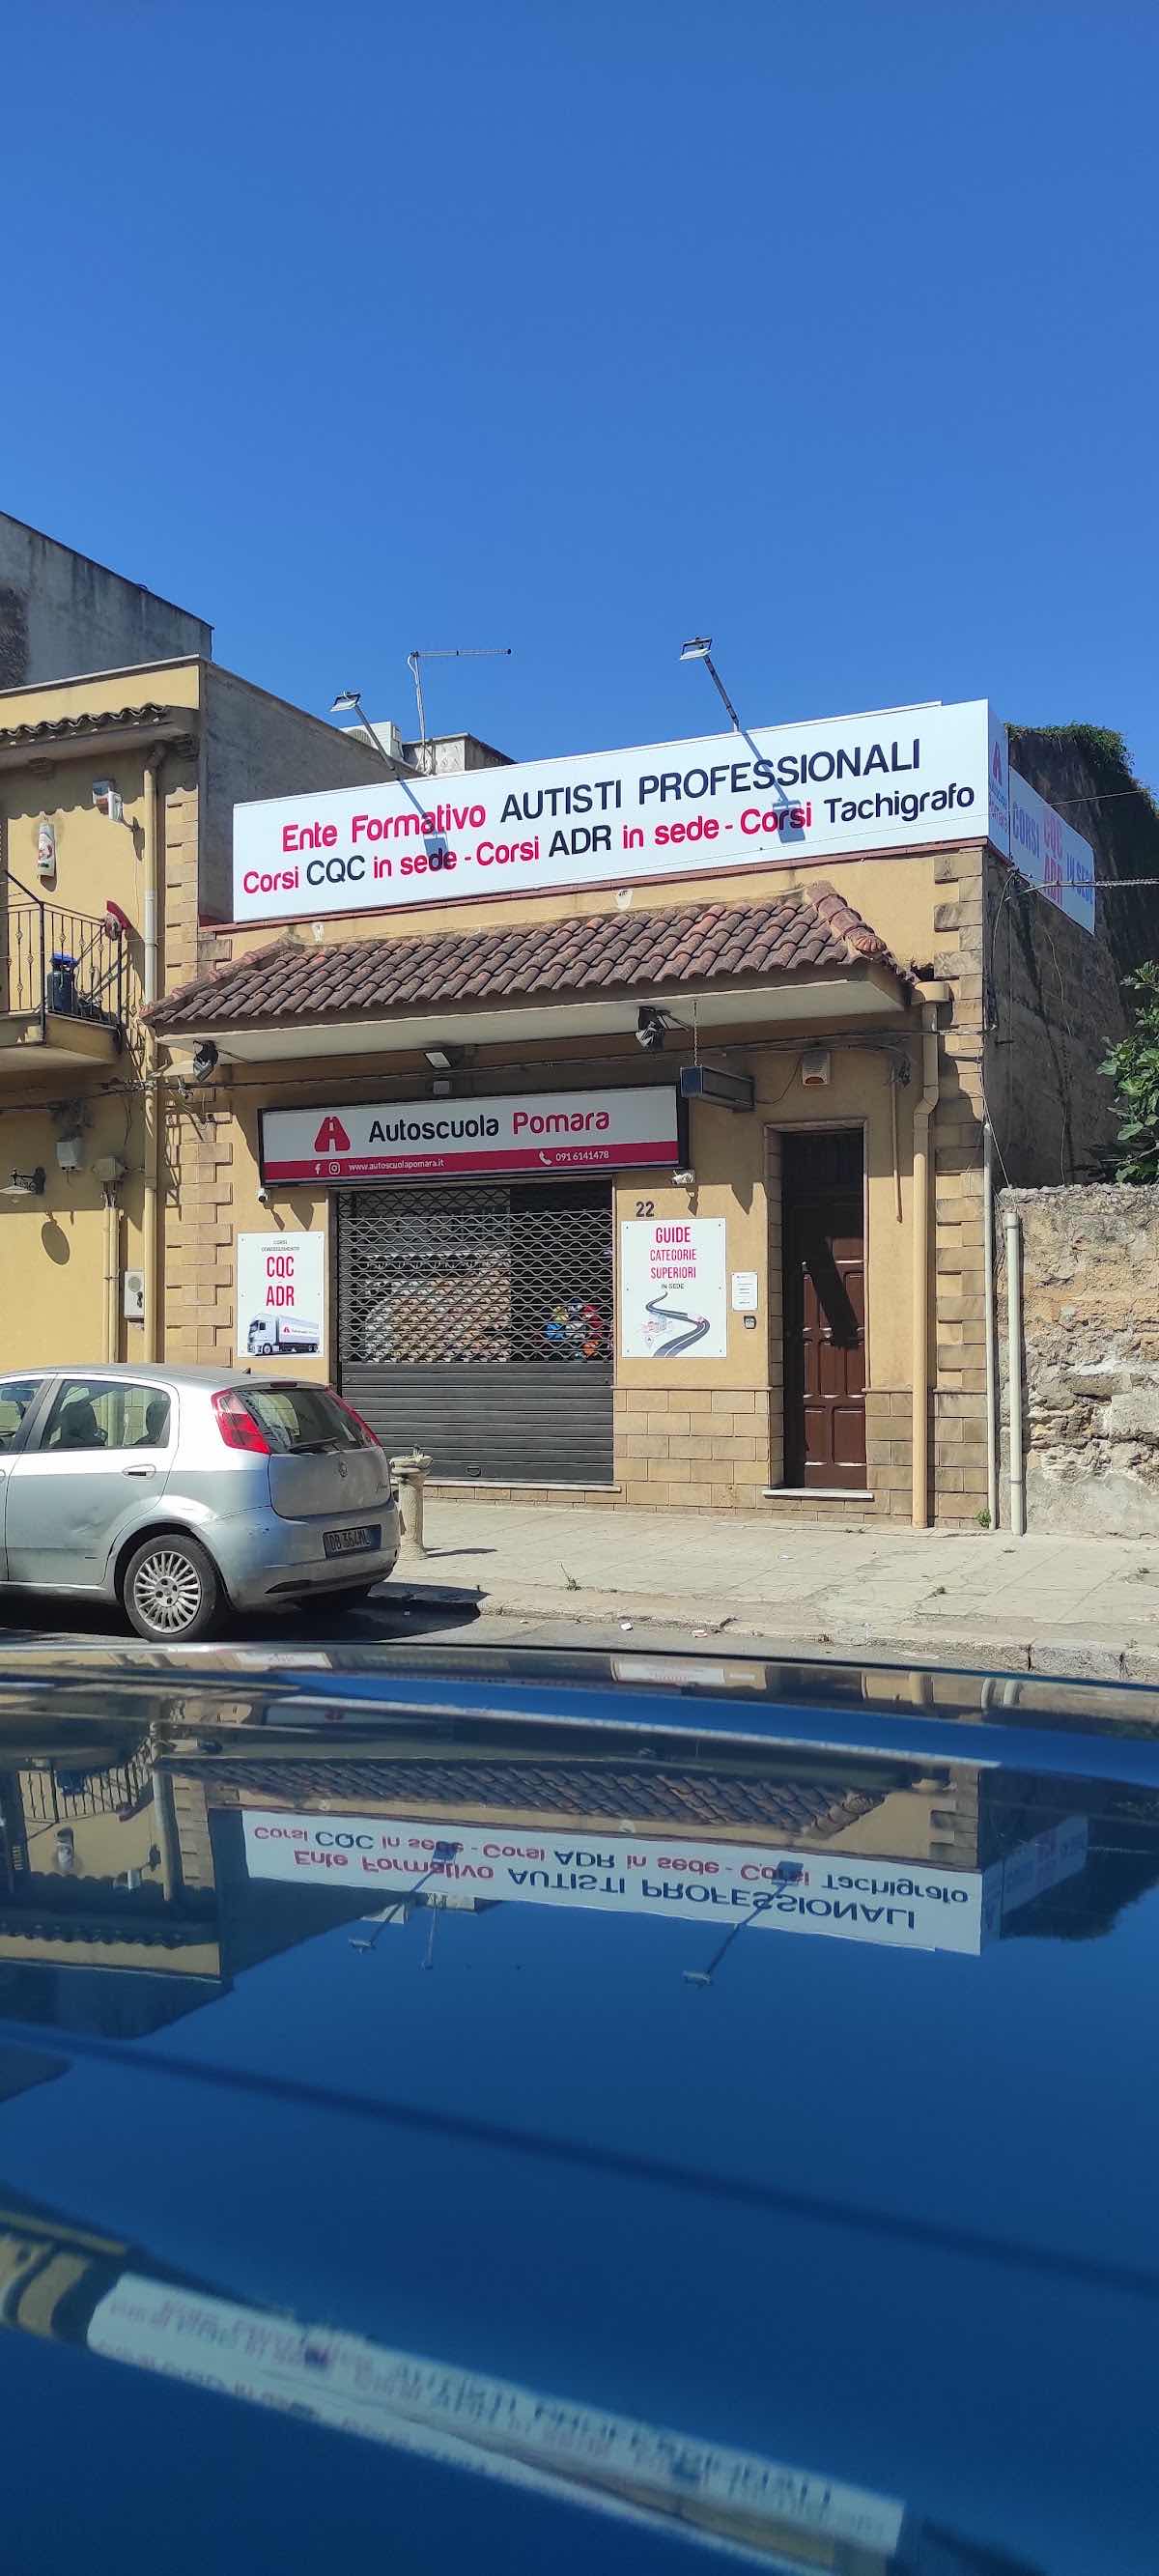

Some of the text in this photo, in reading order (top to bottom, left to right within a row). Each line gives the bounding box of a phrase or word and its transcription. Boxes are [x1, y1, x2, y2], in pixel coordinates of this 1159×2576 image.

[282, 739, 919, 852] Ente Formativo AUTISTI PROFESSIONALI
[243, 866, 299, 894] Corsi
[306, 855, 366, 886] CQC
[374, 856, 392, 879] in
[400, 849, 457, 876] sede
[476, 835, 539, 866] Corsi
[548, 825, 611, 858] ADR
[623, 822, 643, 849] in
[654, 815, 719, 845] sede
[740, 803, 812, 836] Corsi
[824, 782, 975, 824] Tachigrafo
[368, 1110, 609, 1144] Autoscuola Pomara
[349, 1158, 444, 1172] www.autoscuolapomara.it
[555, 1152, 572, 1162] 091
[636, 1201, 655, 1217] 22
[656, 1227, 692, 1244] GUIDE
[650, 1249, 697, 1261] CATEGORIE
[267, 1256, 295, 1278] CQC
[650, 1266, 696, 1280] SUPERIORI
[266, 1285, 295, 1307] ADR
